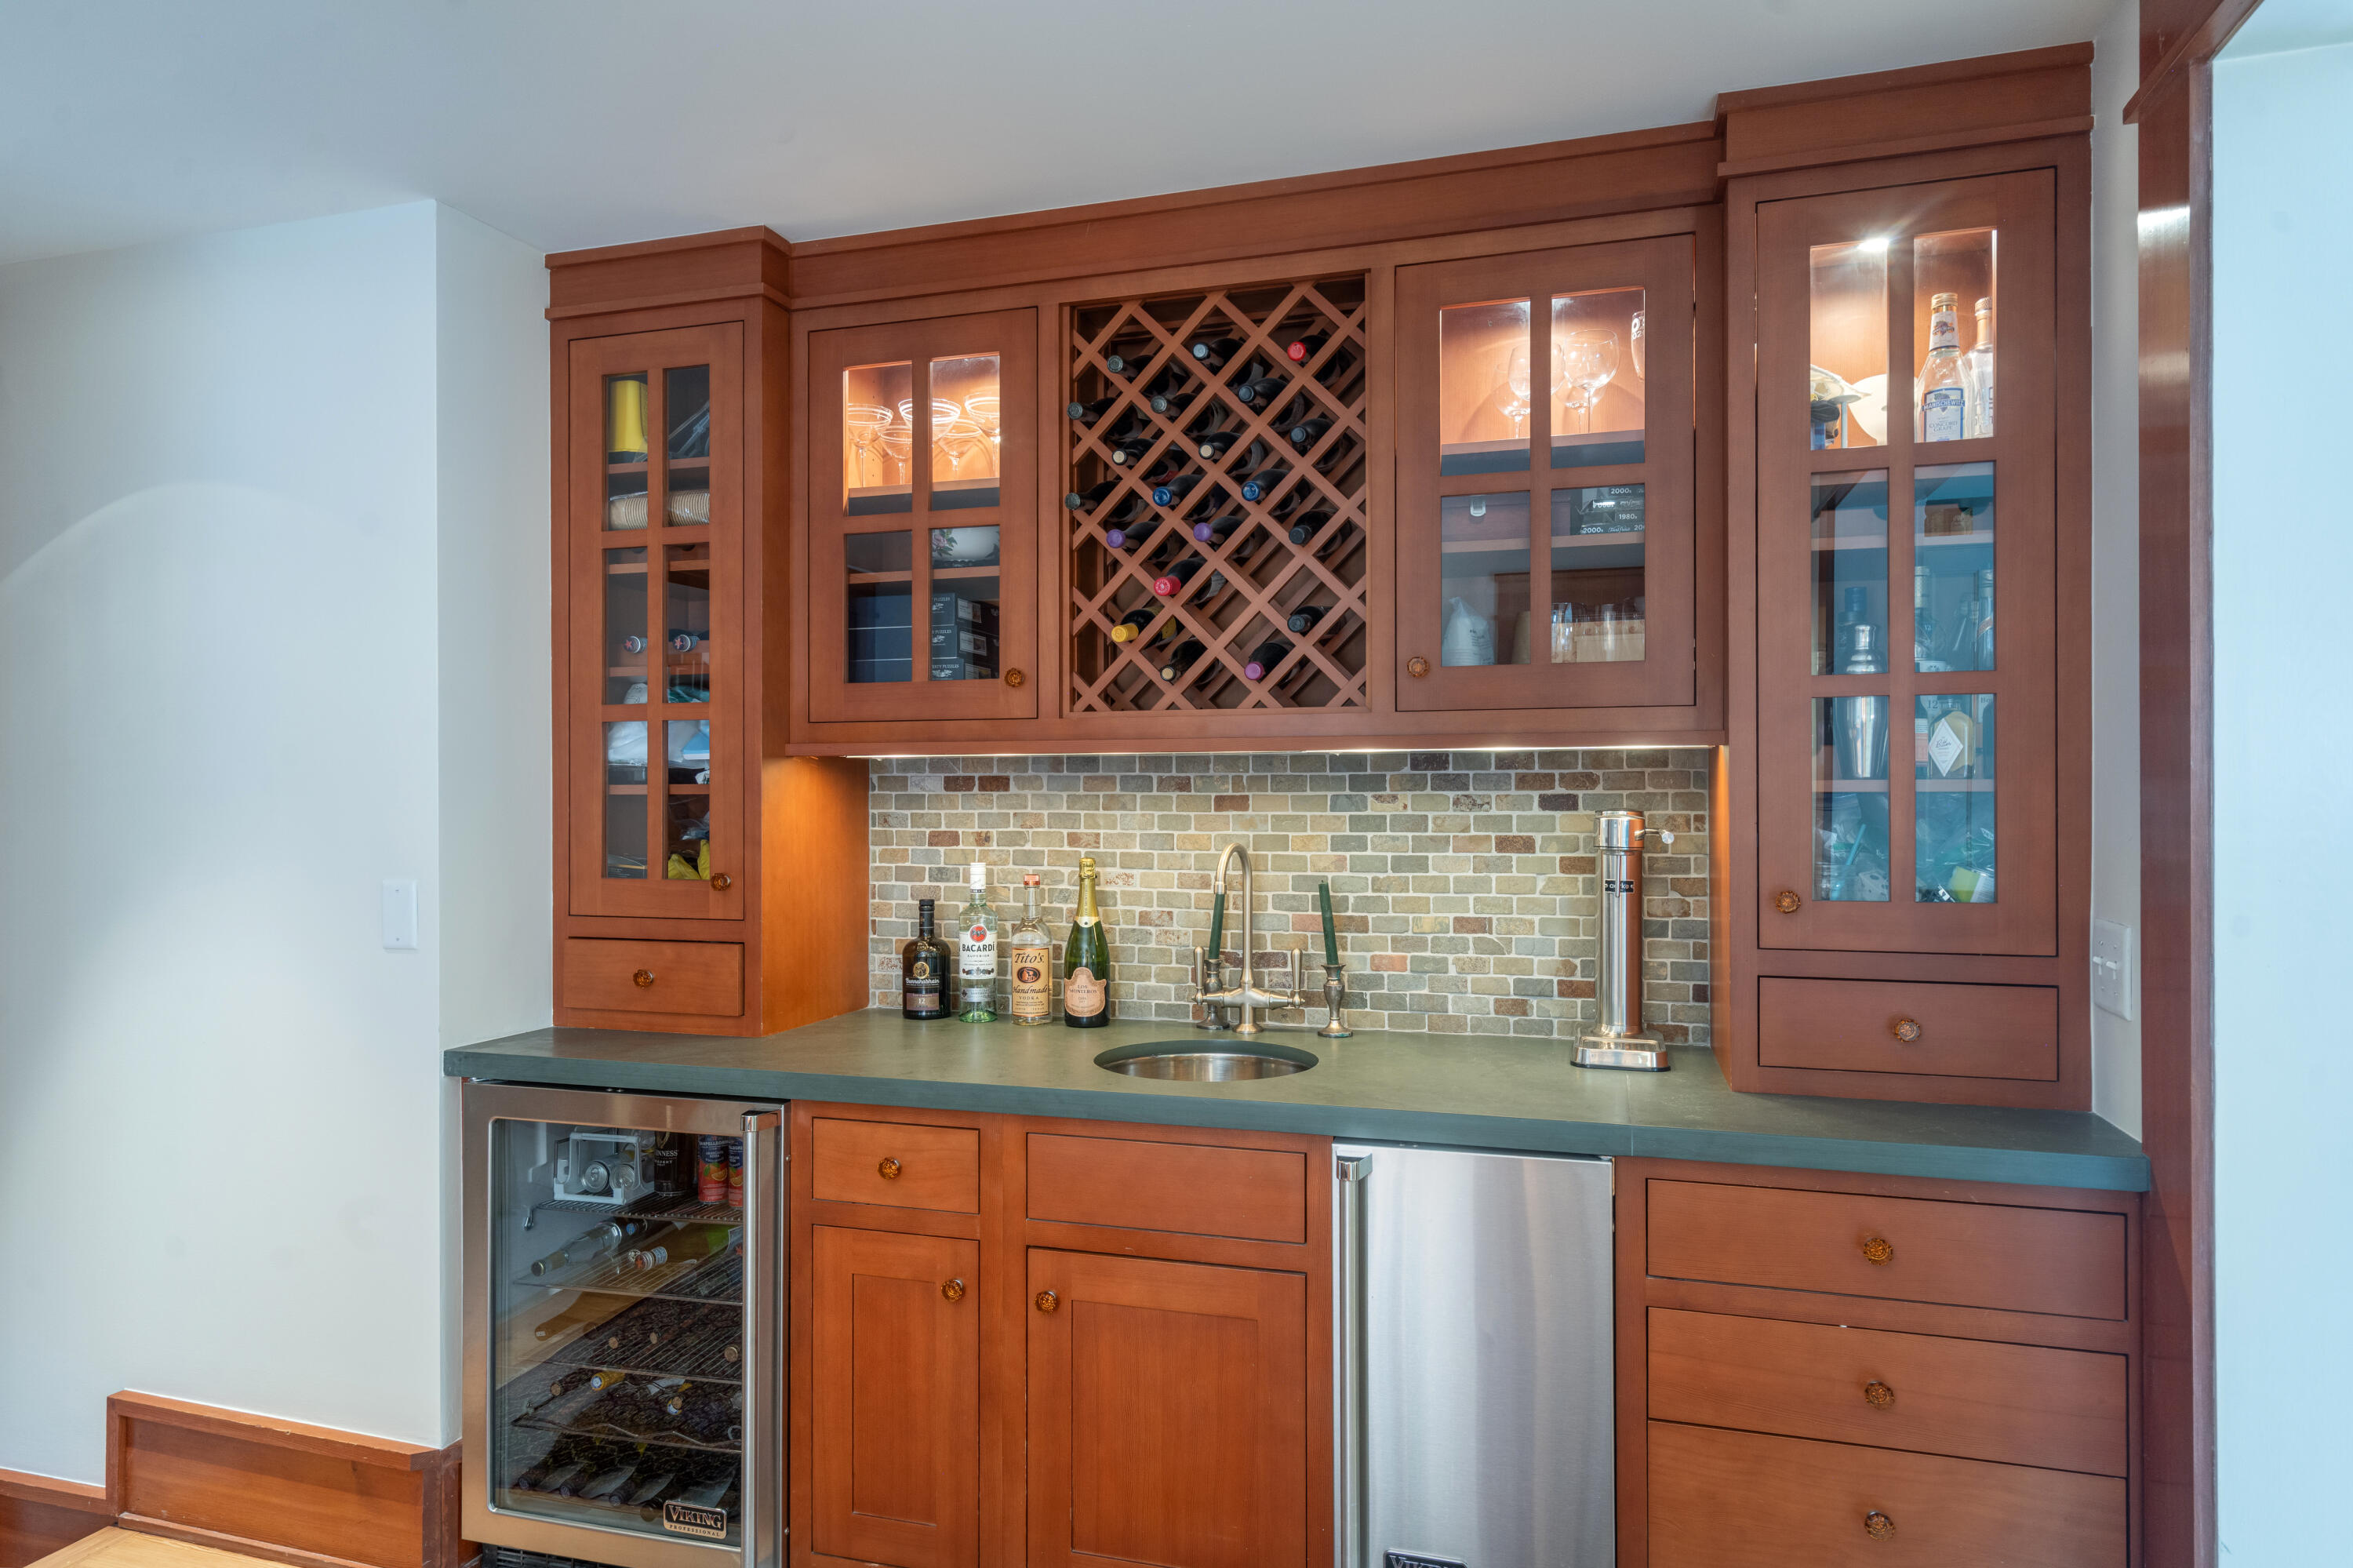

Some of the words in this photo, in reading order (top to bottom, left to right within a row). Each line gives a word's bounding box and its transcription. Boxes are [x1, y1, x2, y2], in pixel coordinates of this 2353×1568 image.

[1927, 700, 1938, 709] 12
[1014, 952, 1044, 963] Tito's
[1013, 984, 1048, 994] Handmade
[668, 1504, 722, 1529] VIKING
[669, 1524, 720, 1537] PROFESSIONAL
